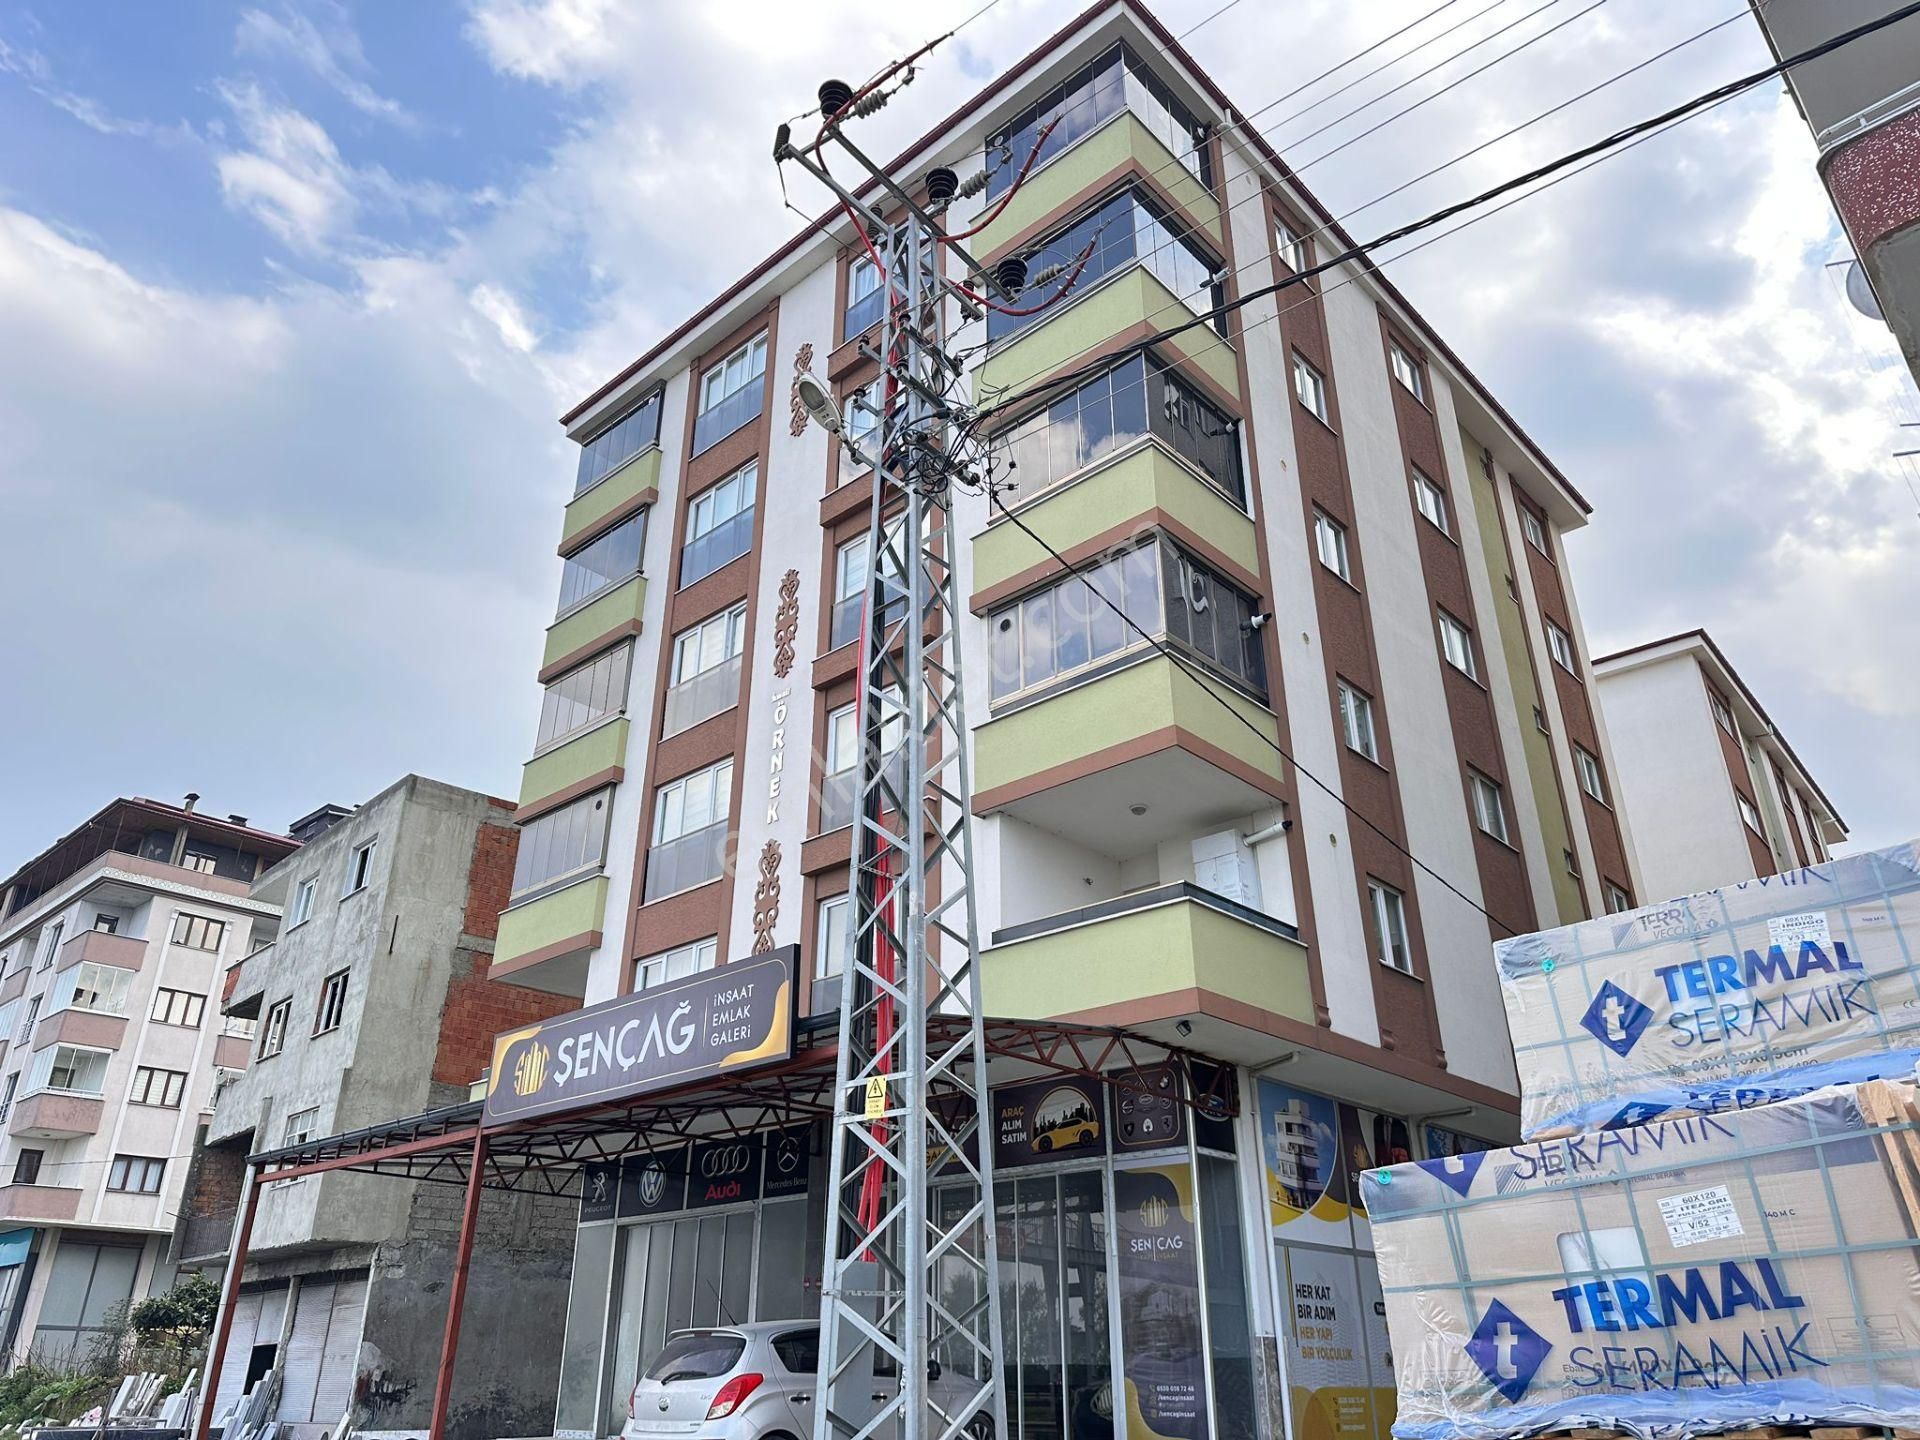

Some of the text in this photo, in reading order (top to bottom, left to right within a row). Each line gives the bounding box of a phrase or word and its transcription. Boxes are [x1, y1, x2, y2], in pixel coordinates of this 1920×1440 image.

[767, 701, 788, 825] ÖRNEK
[1782, 919, 1826, 928] INDIGO
[1654, 940, 1864, 1003] TERMAL
[712, 1004, 751, 1027] EMLAK
[1668, 980, 1878, 1048] SERAMİK
[553, 999, 696, 1088] ŞENÇAĞ
[1001, 1105, 1025, 1119] ARAÇ
[1001, 1121, 1022, 1132] ALIM
[1001, 1132, 1028, 1145] SATIM
[704, 1180, 741, 1200] Audi
[1682, 1190, 1717, 1204] 60X120
[1680, 1202, 1705, 1212] ITEA
[1708, 1197, 1727, 1206] GRI
[1688, 1219, 1710, 1230] V/52
[1295, 1283, 1331, 1300] HER KAT
[1552, 1257, 1806, 1334] TERMAL
[1314, 1305, 1336, 1321] ADIM
[1301, 1326, 1333, 1341] HER YAPI
[1568, 1322, 1831, 1391] SERAMİK
